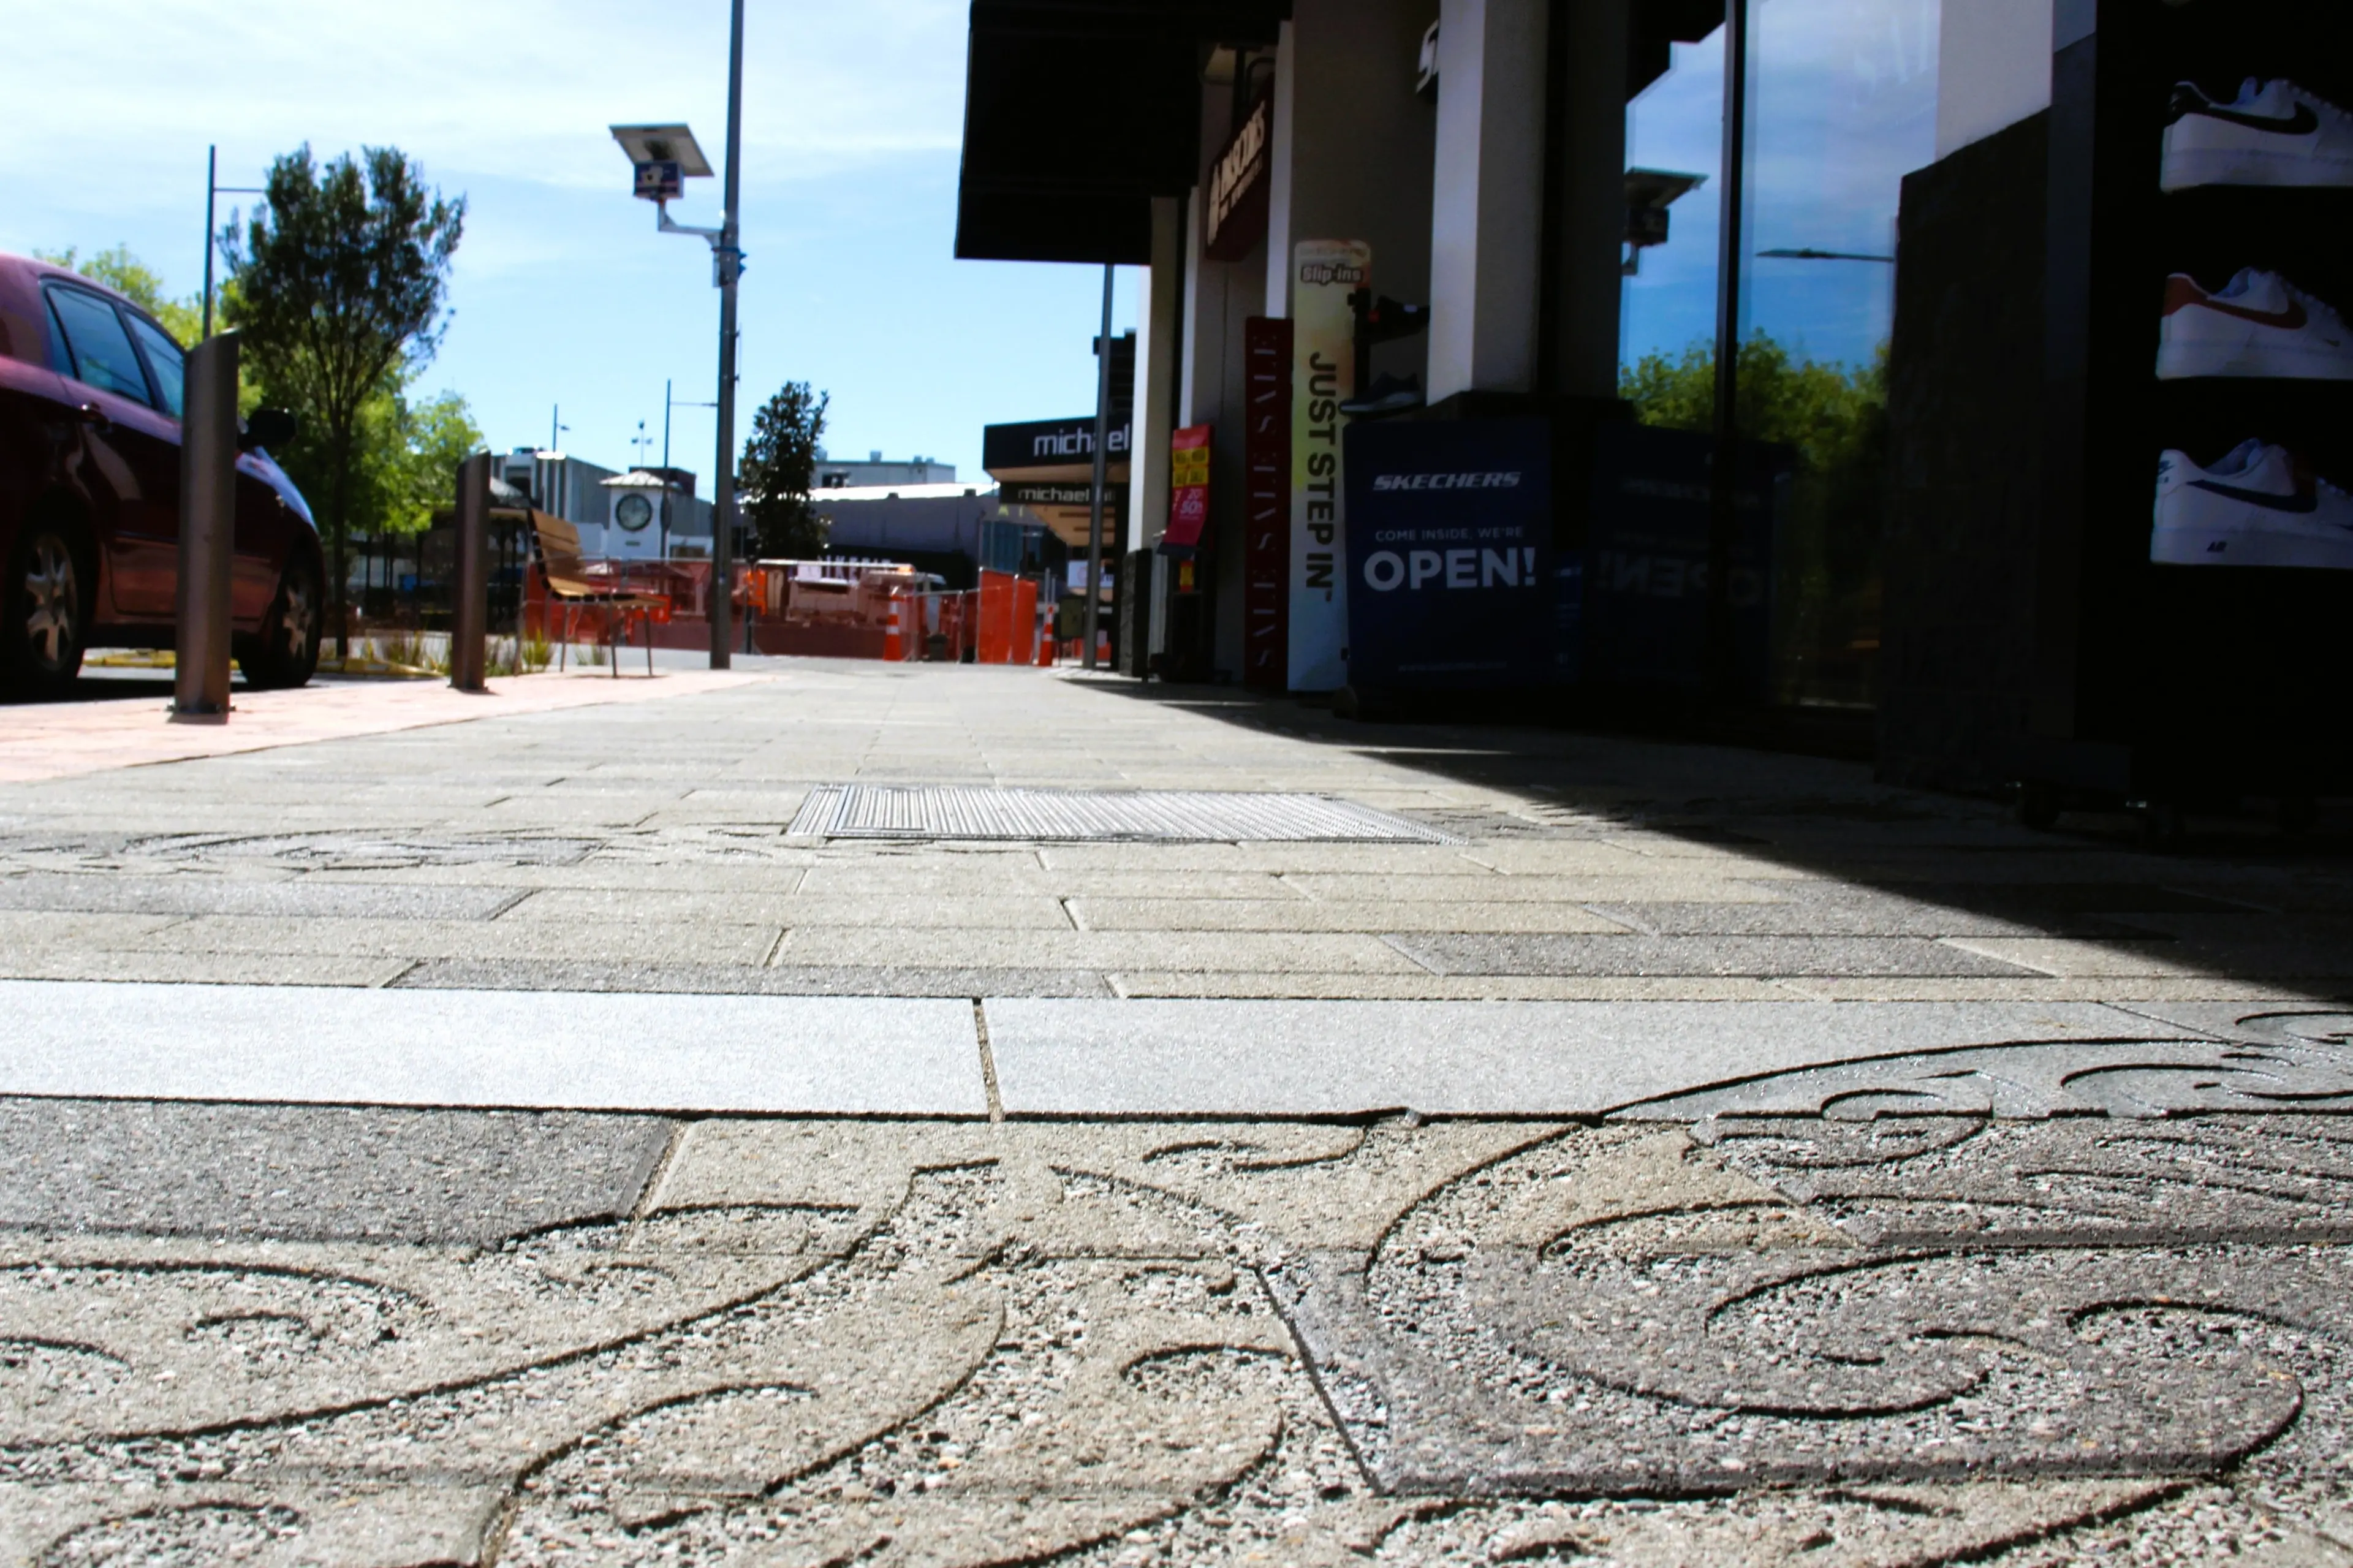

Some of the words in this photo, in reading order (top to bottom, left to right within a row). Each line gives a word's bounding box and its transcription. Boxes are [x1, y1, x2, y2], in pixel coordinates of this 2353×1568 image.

[1252, 335, 1277, 435] SALE
[1309, 352, 1336, 445] JUST
[1018, 486, 1090, 502] michael
[1252, 452, 1277, 551] SALE
[1308, 452, 1335, 545] STEP
[1372, 471, 1522, 491] SKECHERS
[1363, 546, 1537, 593] OPEN!
[1375, 528, 1416, 543] COME
[1477, 525, 1524, 539] WE'RE
[1252, 567, 1277, 670] SALE
